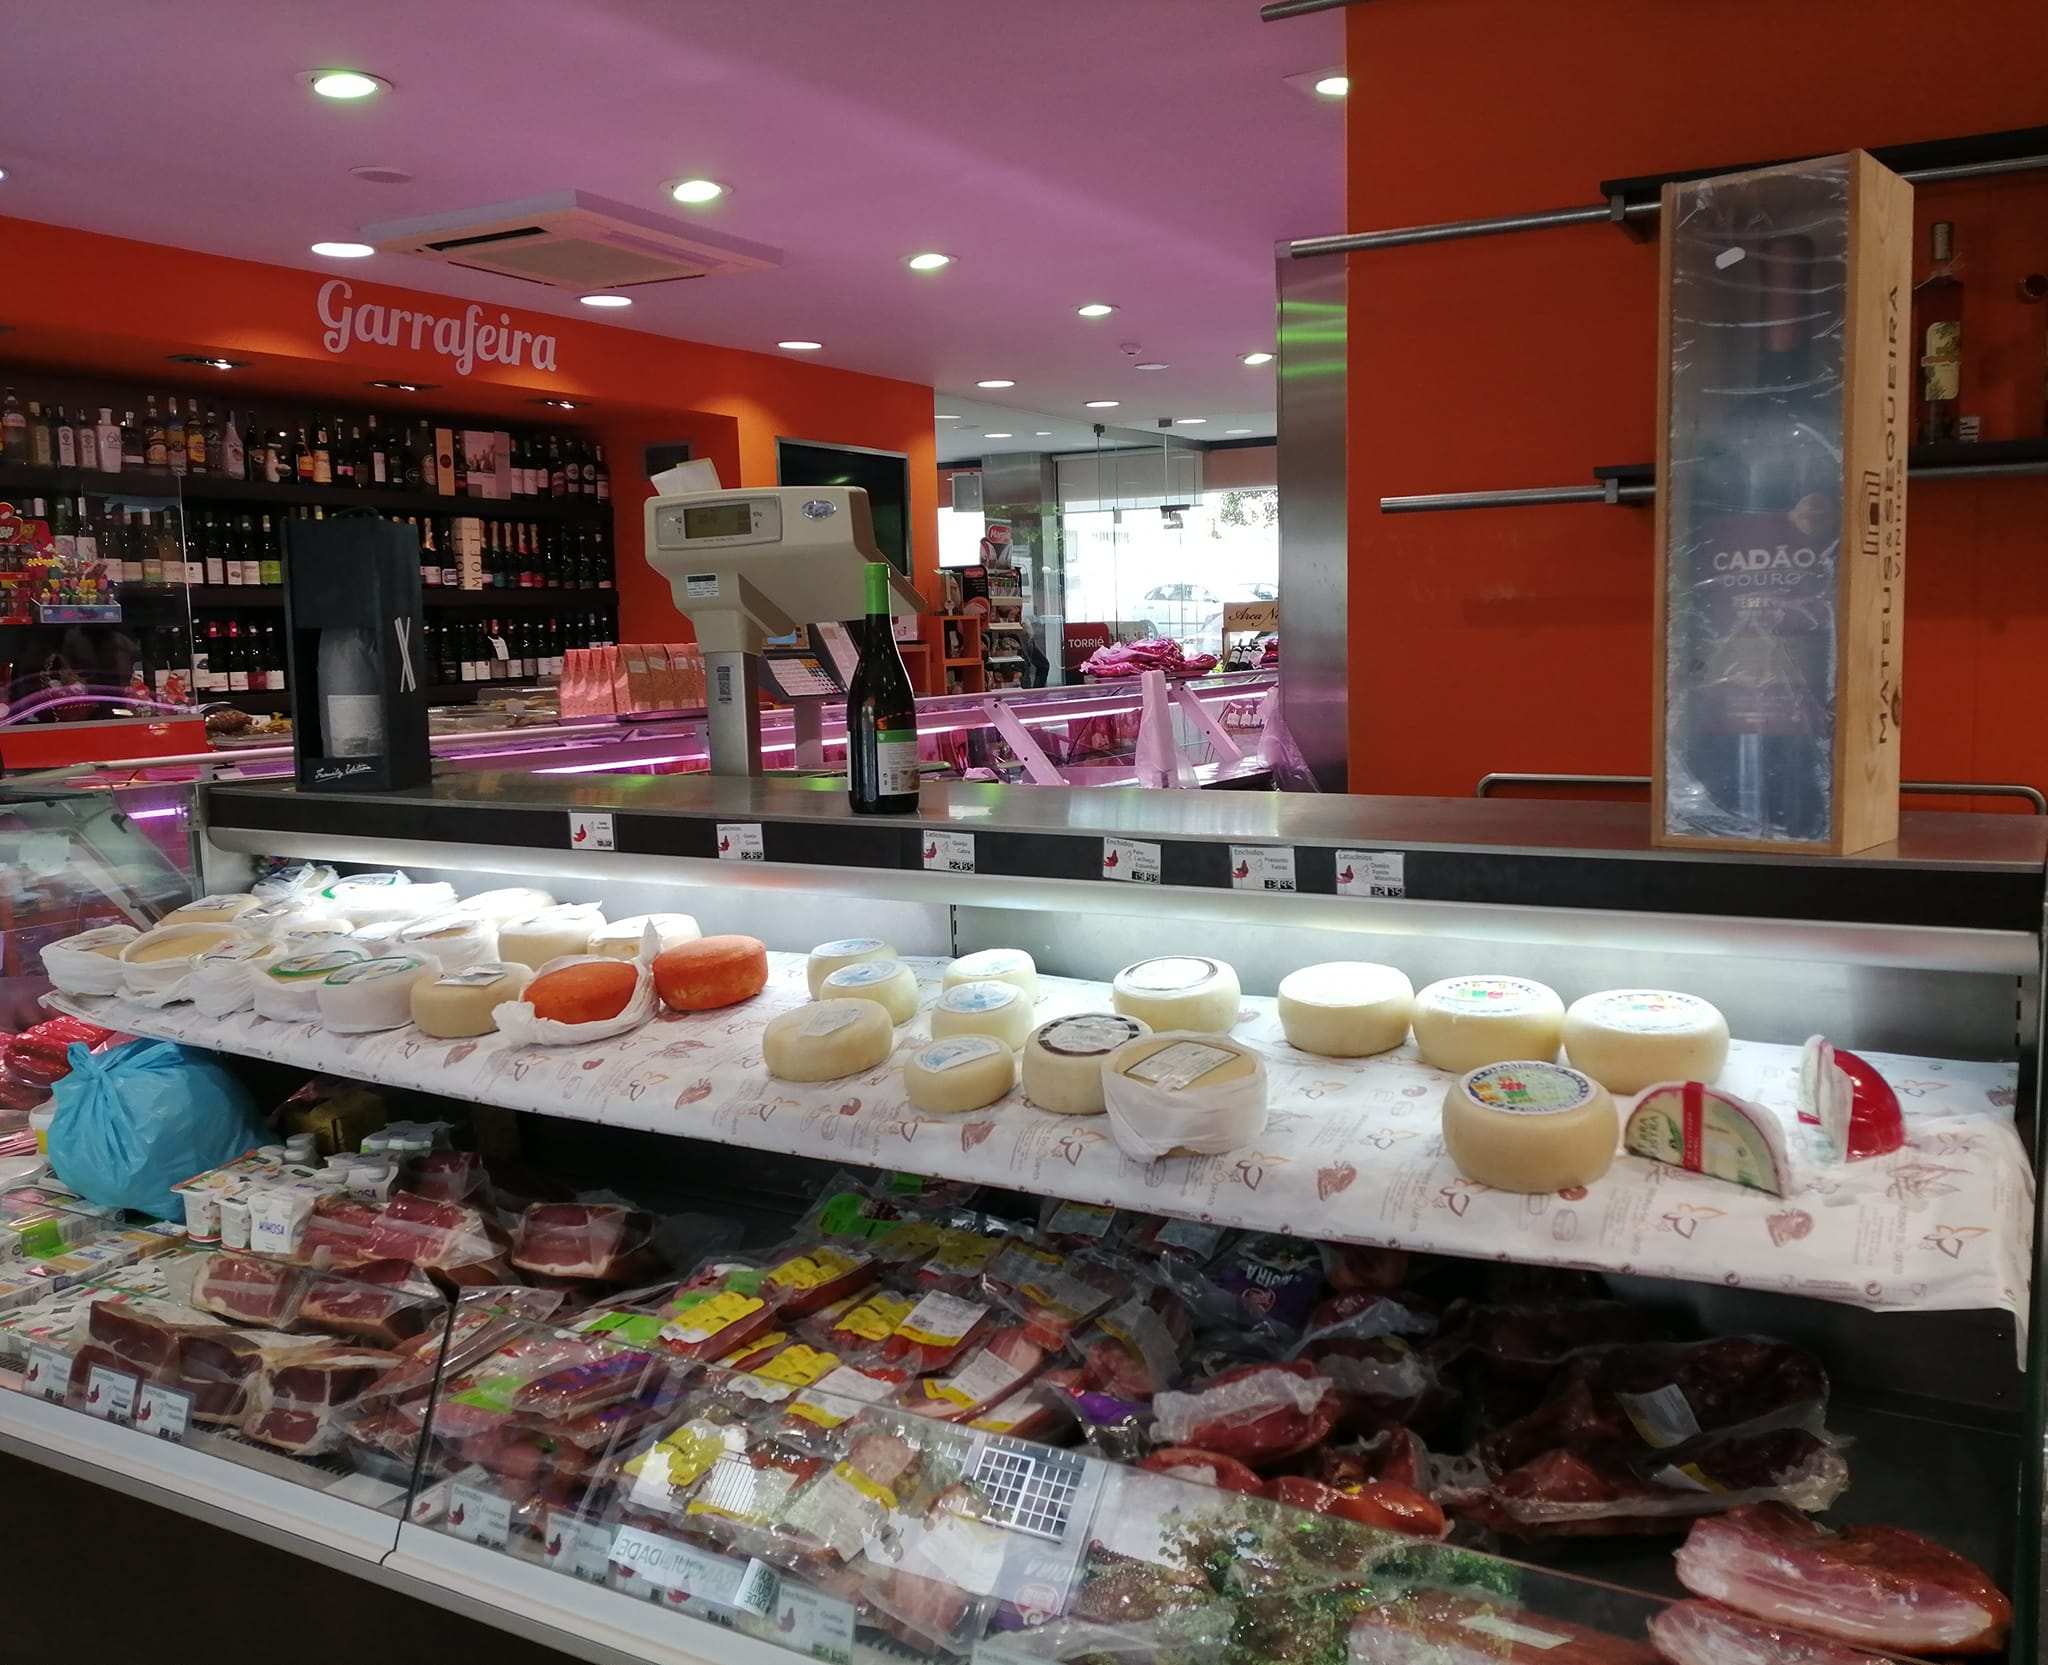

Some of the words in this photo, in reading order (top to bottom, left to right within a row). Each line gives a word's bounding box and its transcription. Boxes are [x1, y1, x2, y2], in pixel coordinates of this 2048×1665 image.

[317, 279, 557, 376] Garrafeira
[1713, 545, 1816, 572] CADÃO
[1234, 848, 1264, 856] Enchidos
